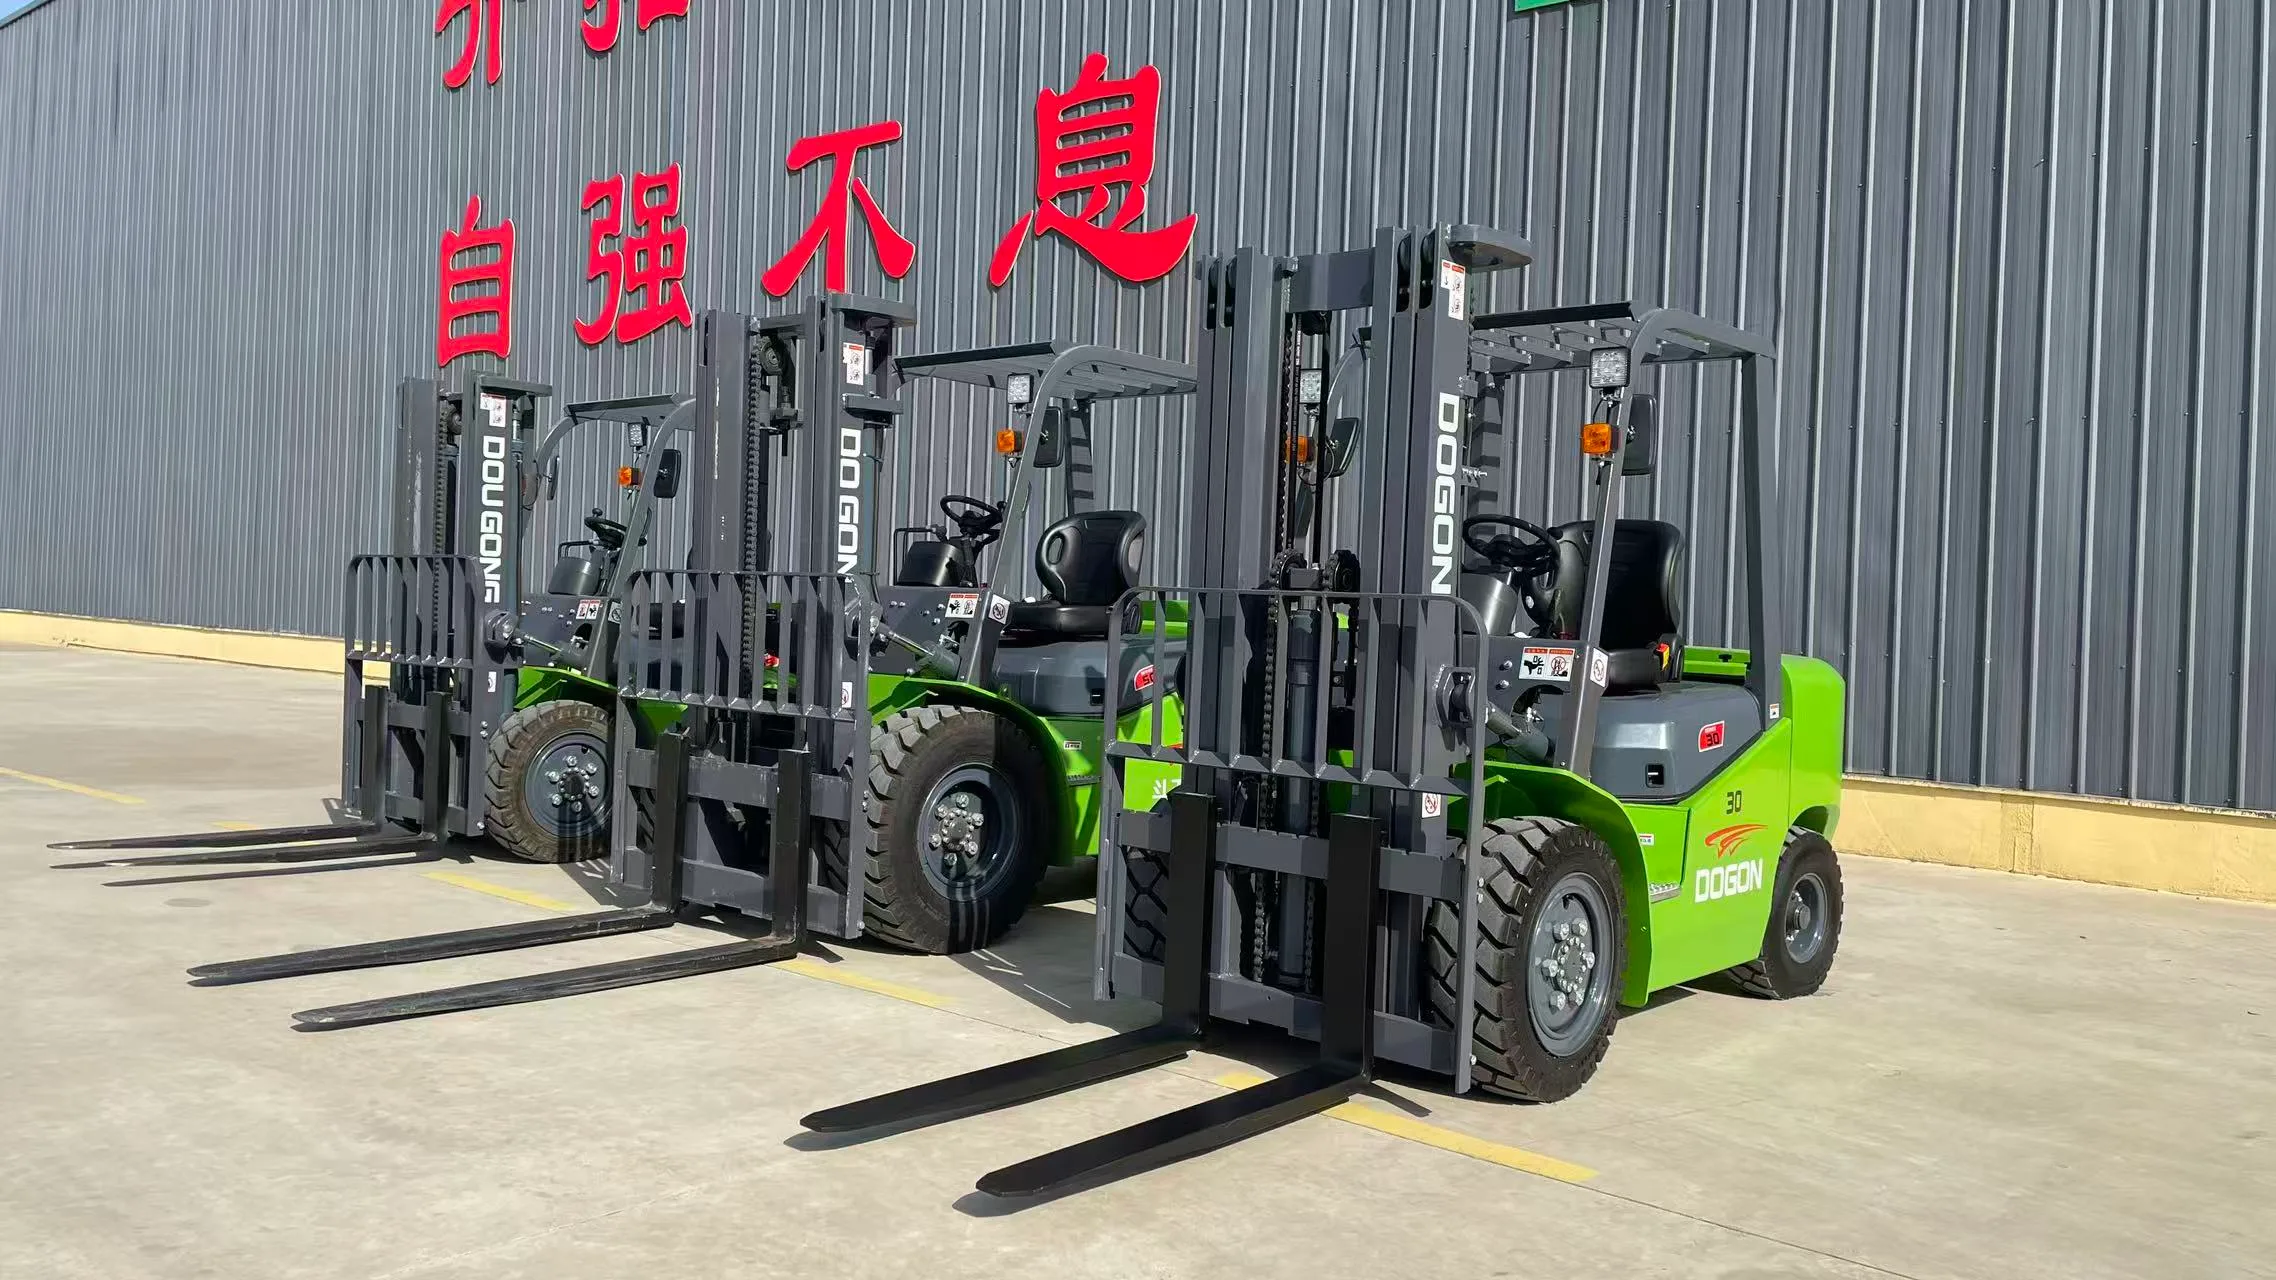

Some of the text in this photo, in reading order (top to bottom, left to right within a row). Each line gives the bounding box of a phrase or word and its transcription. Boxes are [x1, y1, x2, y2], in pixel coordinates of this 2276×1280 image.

[437, 53, 1197, 366] 自强不息
[1431, 392, 1460, 594] DOGON
[1706, 733, 1720, 746] 30
[1726, 790, 1742, 814] 30
[1695, 859, 1763, 903] DOGON
